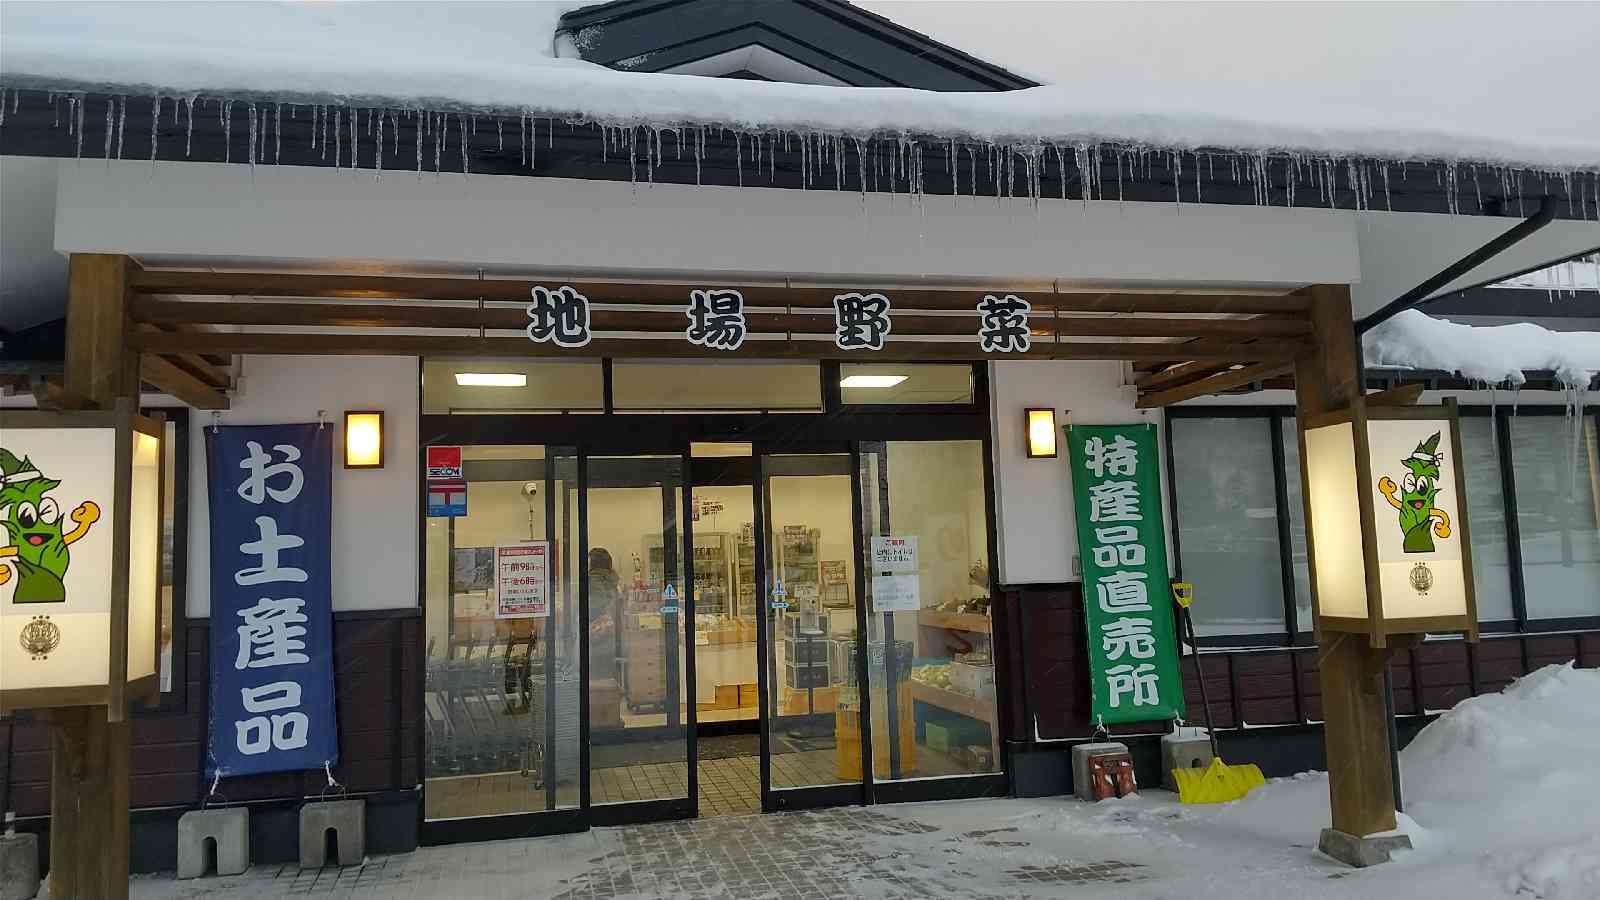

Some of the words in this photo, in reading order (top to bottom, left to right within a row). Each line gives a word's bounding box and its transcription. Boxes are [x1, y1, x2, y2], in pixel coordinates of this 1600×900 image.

[527, 284, 1032, 353] 地場野菜
[430, 468, 460, 476] SECOM
[235, 440, 310, 756] お土産品
[1084, 434, 1160, 709] 特産品直売所
